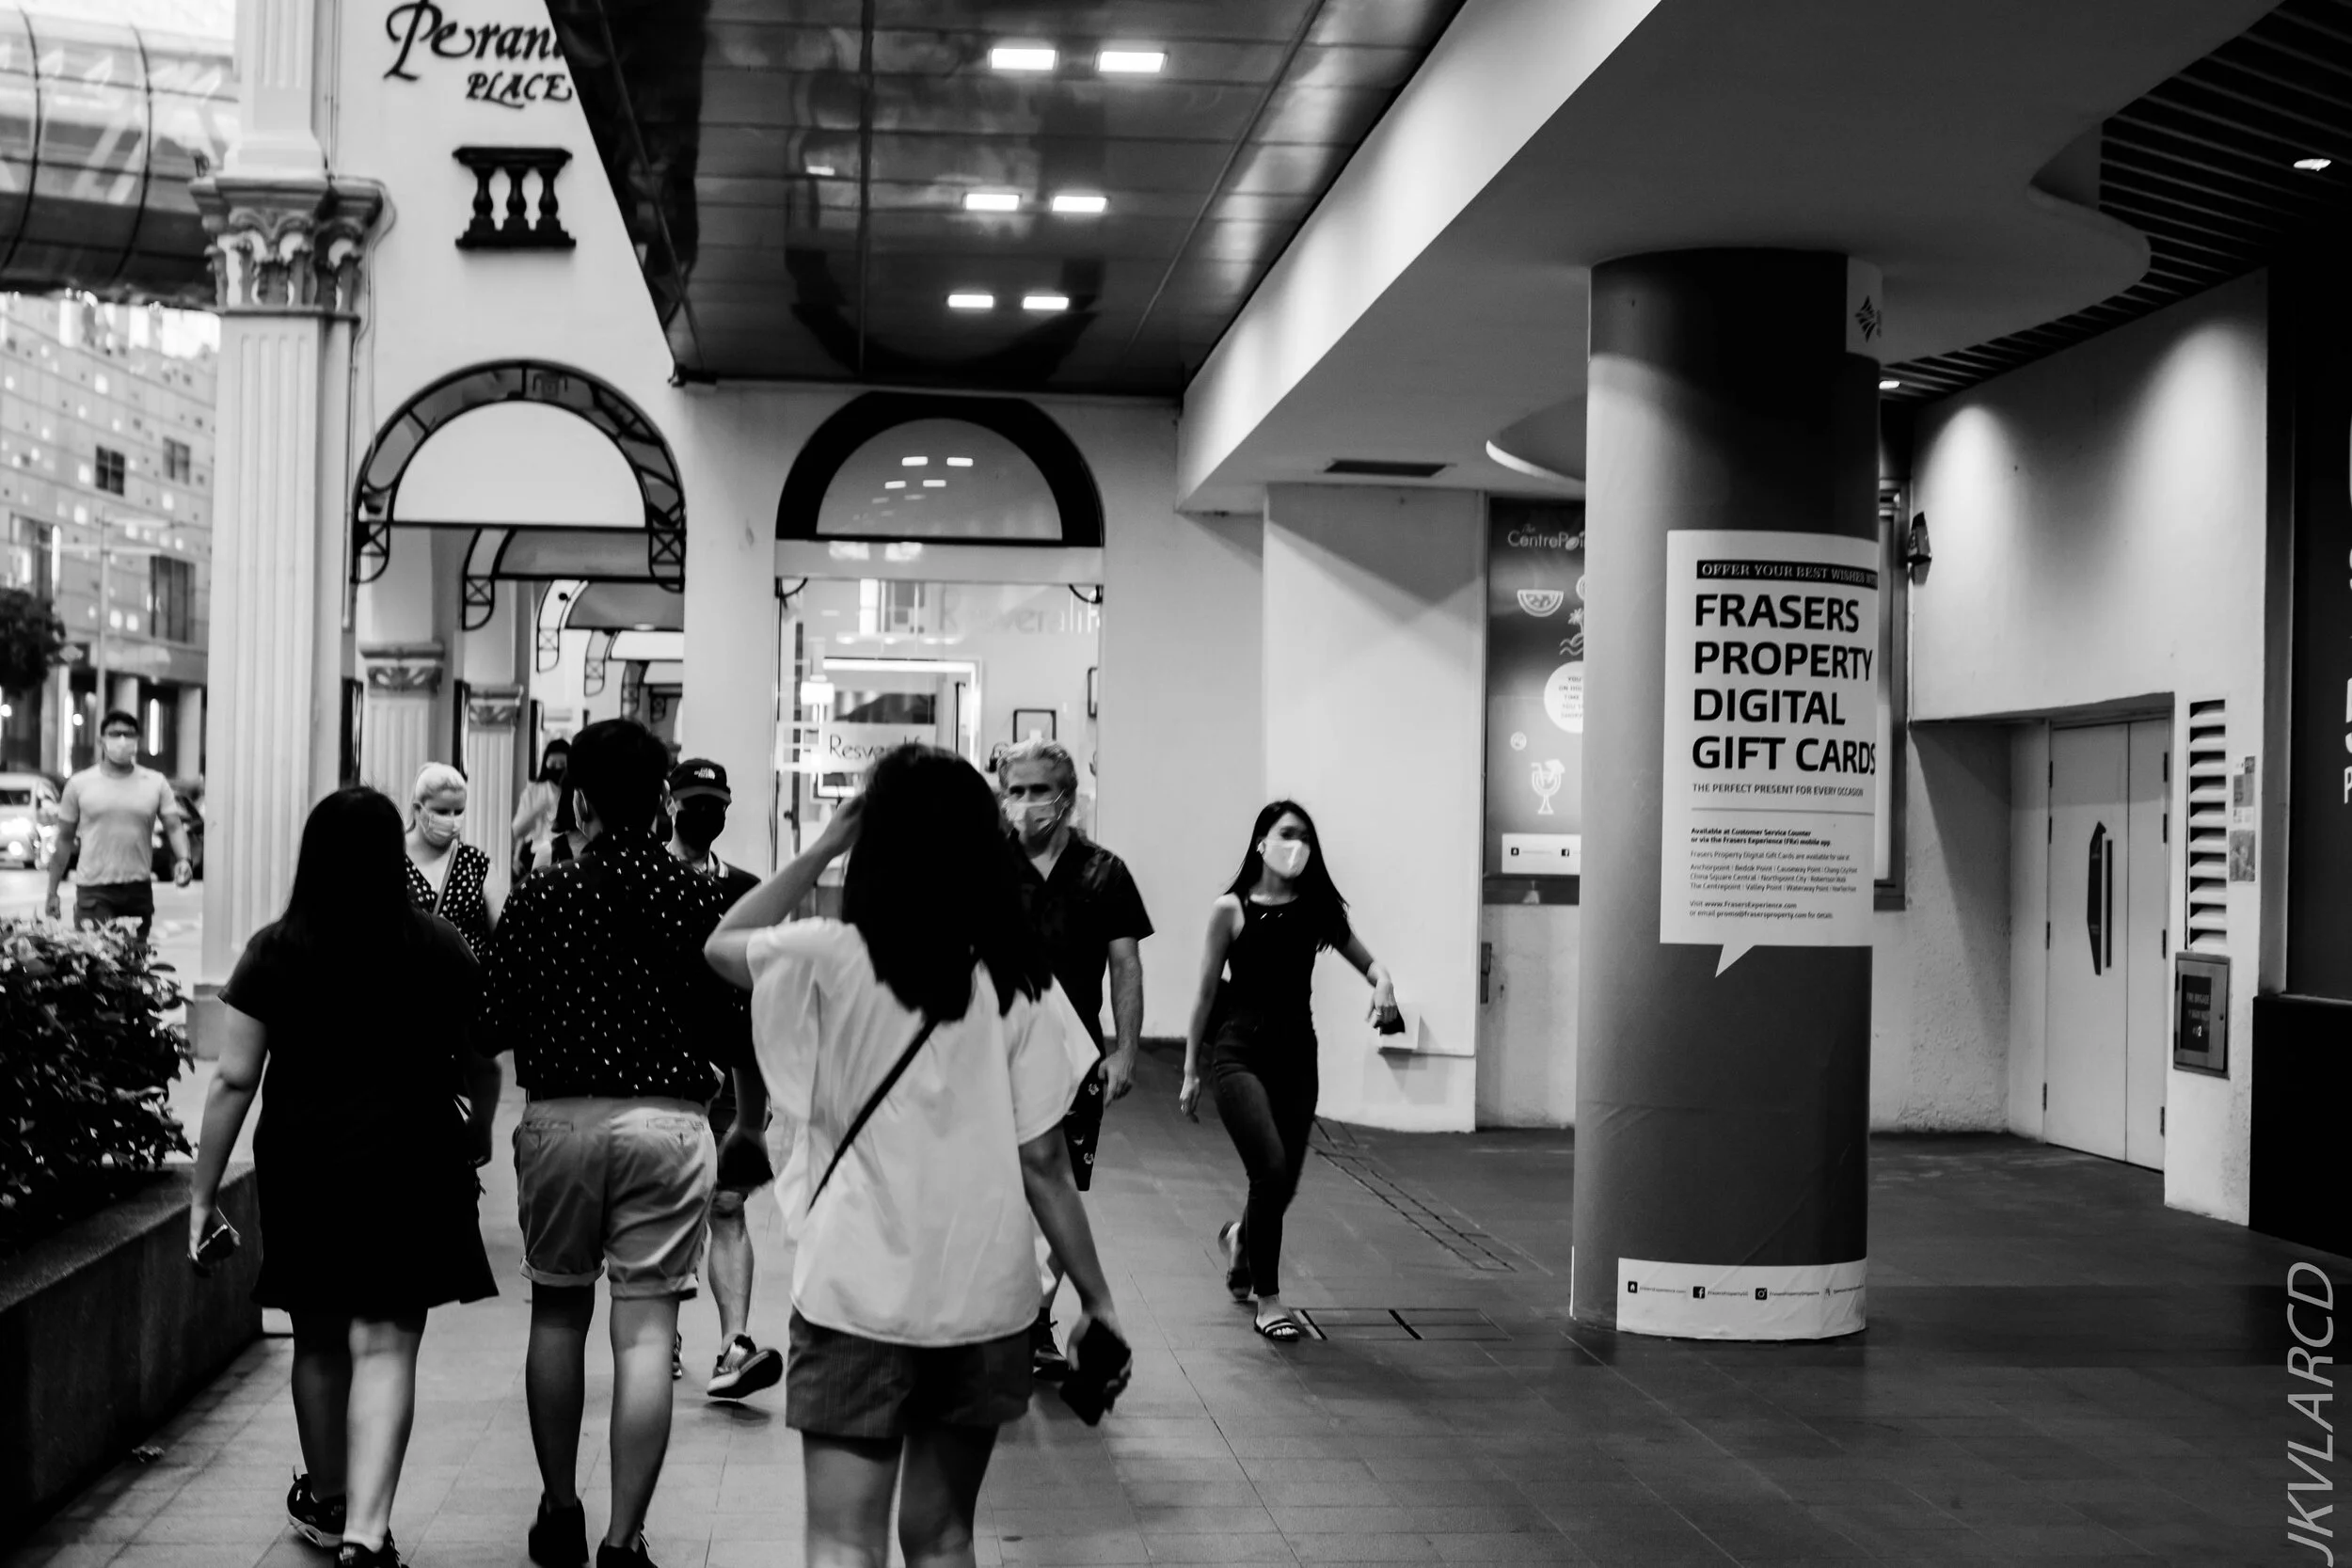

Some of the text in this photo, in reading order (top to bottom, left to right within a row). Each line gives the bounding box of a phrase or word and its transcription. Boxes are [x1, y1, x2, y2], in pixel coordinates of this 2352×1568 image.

[466, 71, 572, 109] PLACE
[1507, 530, 1584, 551] CentrePoi
[1701, 563, 1750, 577] OFFER
[1754, 564, 1793, 578] YOUR
[1796, 565, 1827, 579] BEST
[1831, 567, 1866, 583] WISHES
[1695, 594, 1859, 633] FRASERS
[1694, 641, 1872, 681] PROPERTY
[1693, 688, 1846, 725] DIGITAL
[1692, 736, 1876, 775] GIFT CARDS
[1692, 784, 1710, 792] THE
[1712, 784, 1753, 793] PERFECT
[1754, 784, 1795, 795] PRESENT
[1795, 785, 1812, 796] FOR
[1813, 785, 1837, 797] EVERY
[1723, 836, 1747, 845] Frasers
